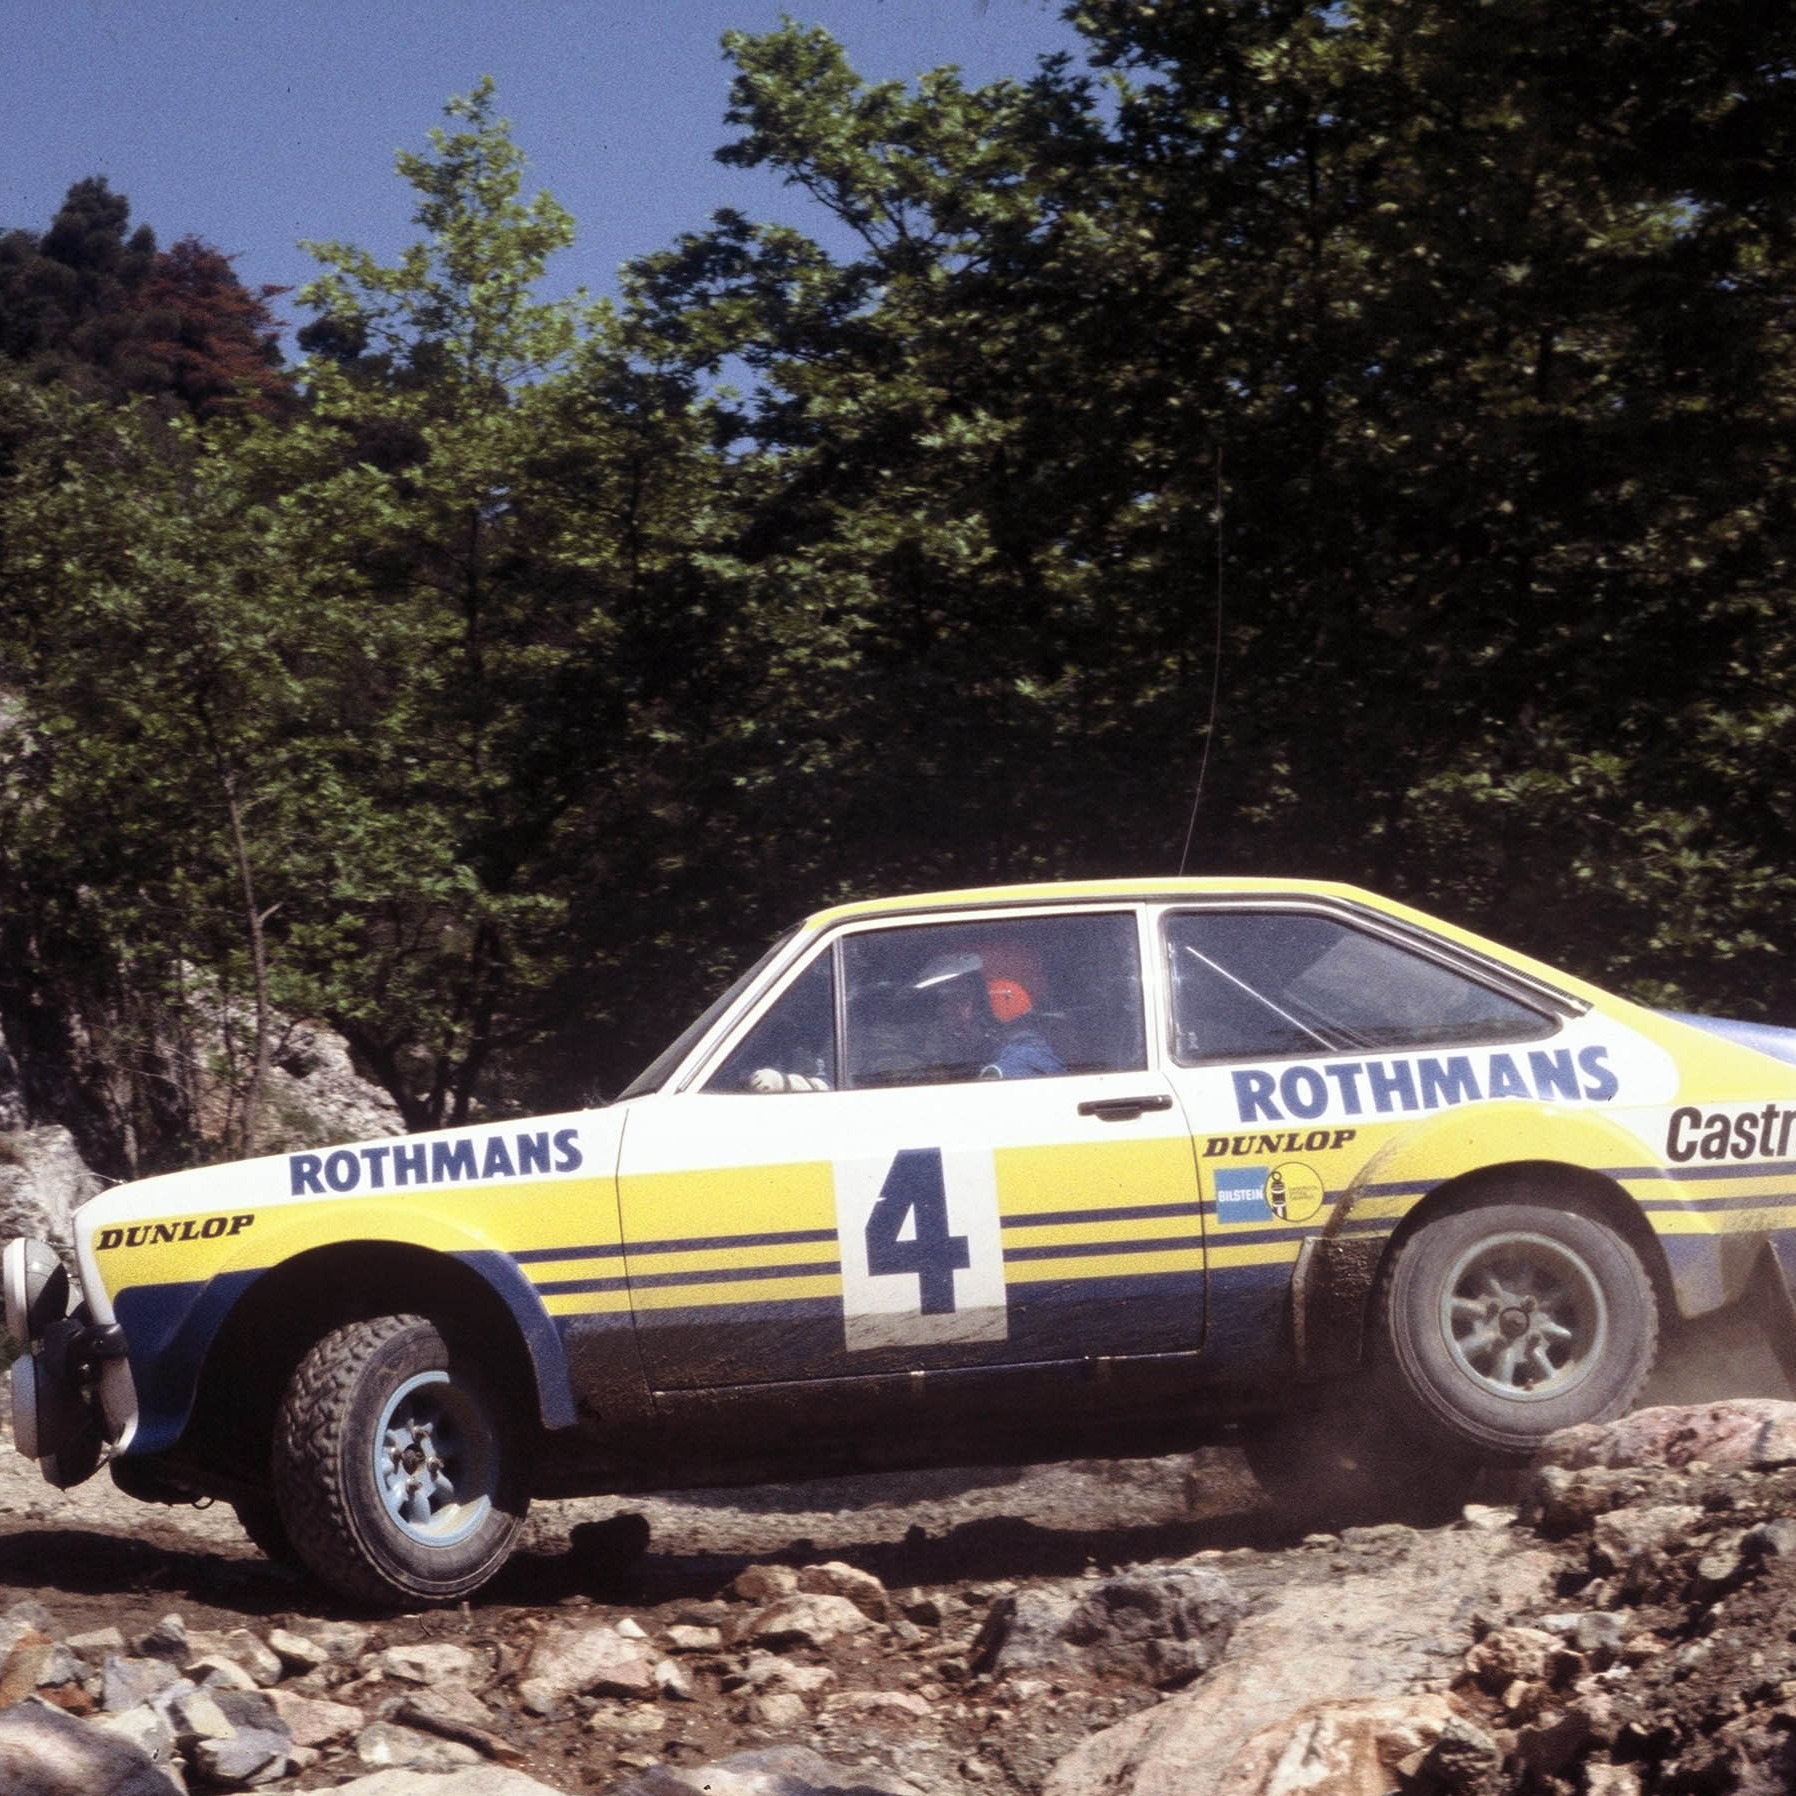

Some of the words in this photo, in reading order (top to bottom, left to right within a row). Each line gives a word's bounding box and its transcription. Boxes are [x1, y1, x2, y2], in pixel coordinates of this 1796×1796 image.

[1231, 1045, 1620, 1123] ROTHMANS
[289, 1128, 583, 1197] ROTHMANS
[1202, 1129, 1356, 1157] DUNLOP
[1218, 1188, 1264, 1203] BILSTEIN
[96, 1214, 255, 1250] DUNLOP
[865, 1147, 971, 1316] 4
